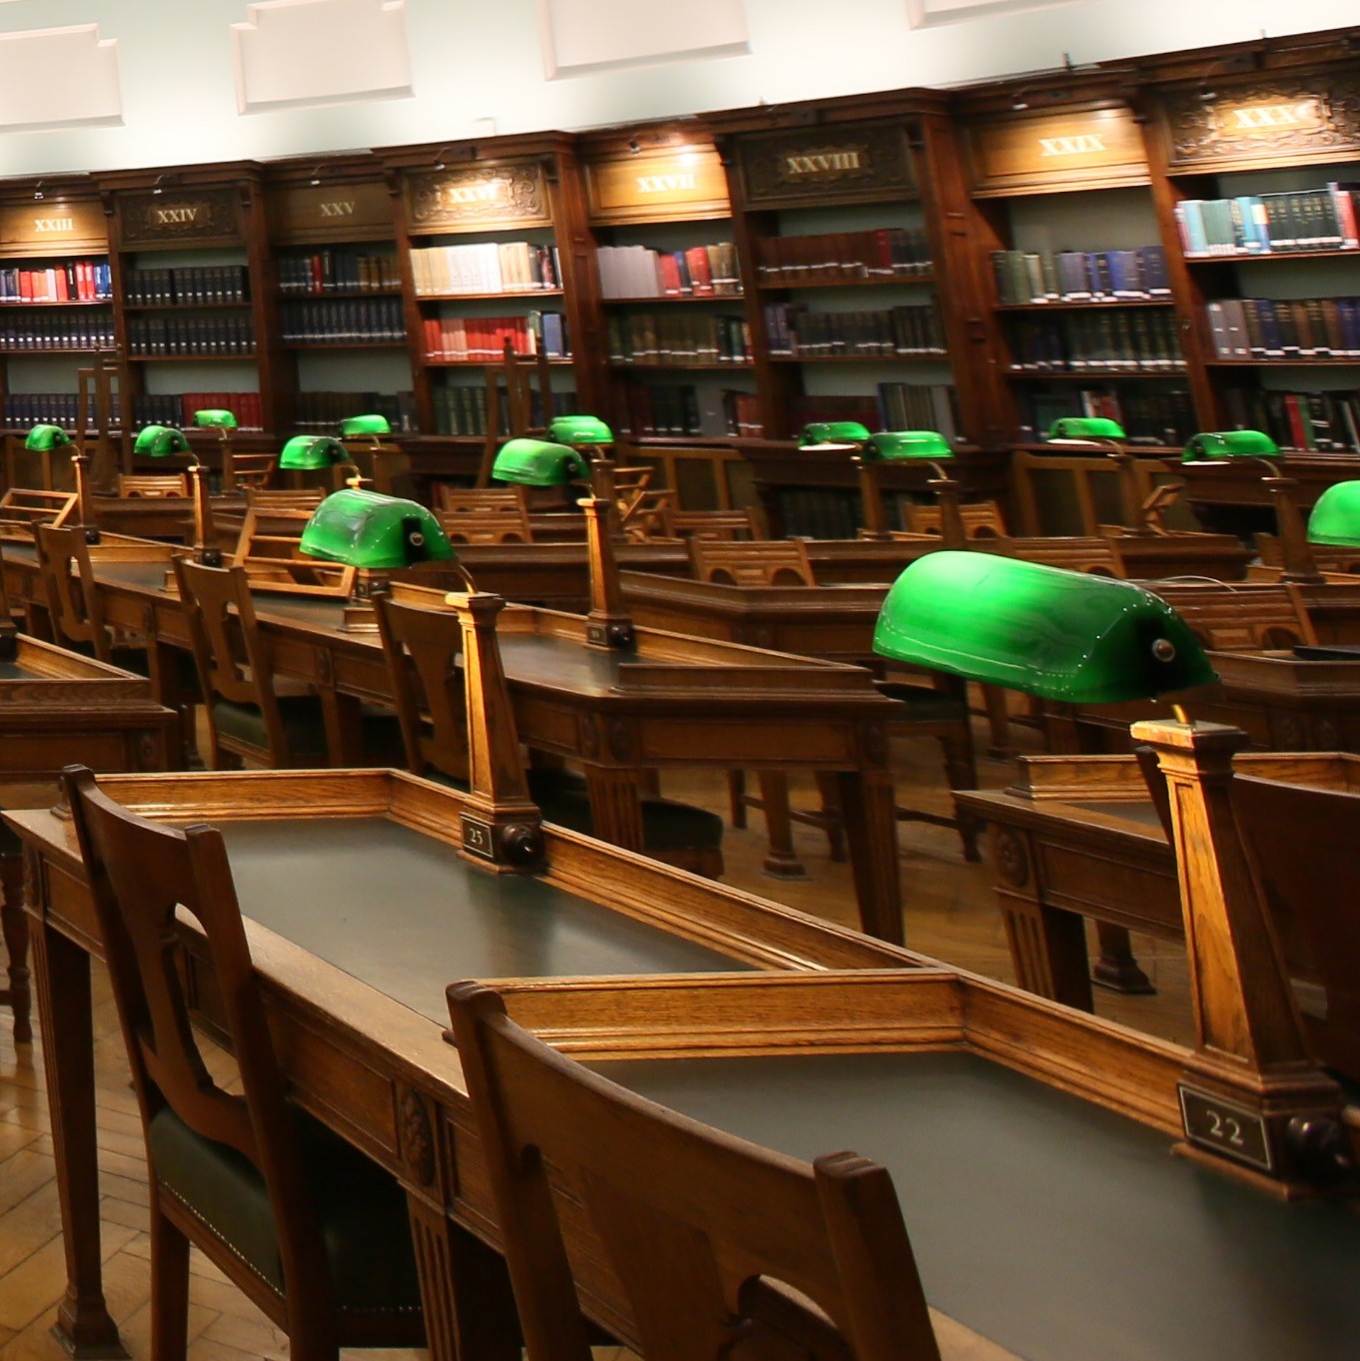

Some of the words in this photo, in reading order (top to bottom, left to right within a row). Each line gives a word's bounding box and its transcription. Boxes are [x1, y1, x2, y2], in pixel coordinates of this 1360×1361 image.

[1234, 106, 1297, 129] XXX
[1039, 134, 1107, 157] XXIX
[787, 152, 860, 174] XXVIII
[636, 174, 696, 193] XXVII
[158, 208, 198, 223] XXIV
[320, 201, 356, 217] XXV
[34, 218, 73, 233] XXIII
[1206, 1110, 1244, 1146] 22
